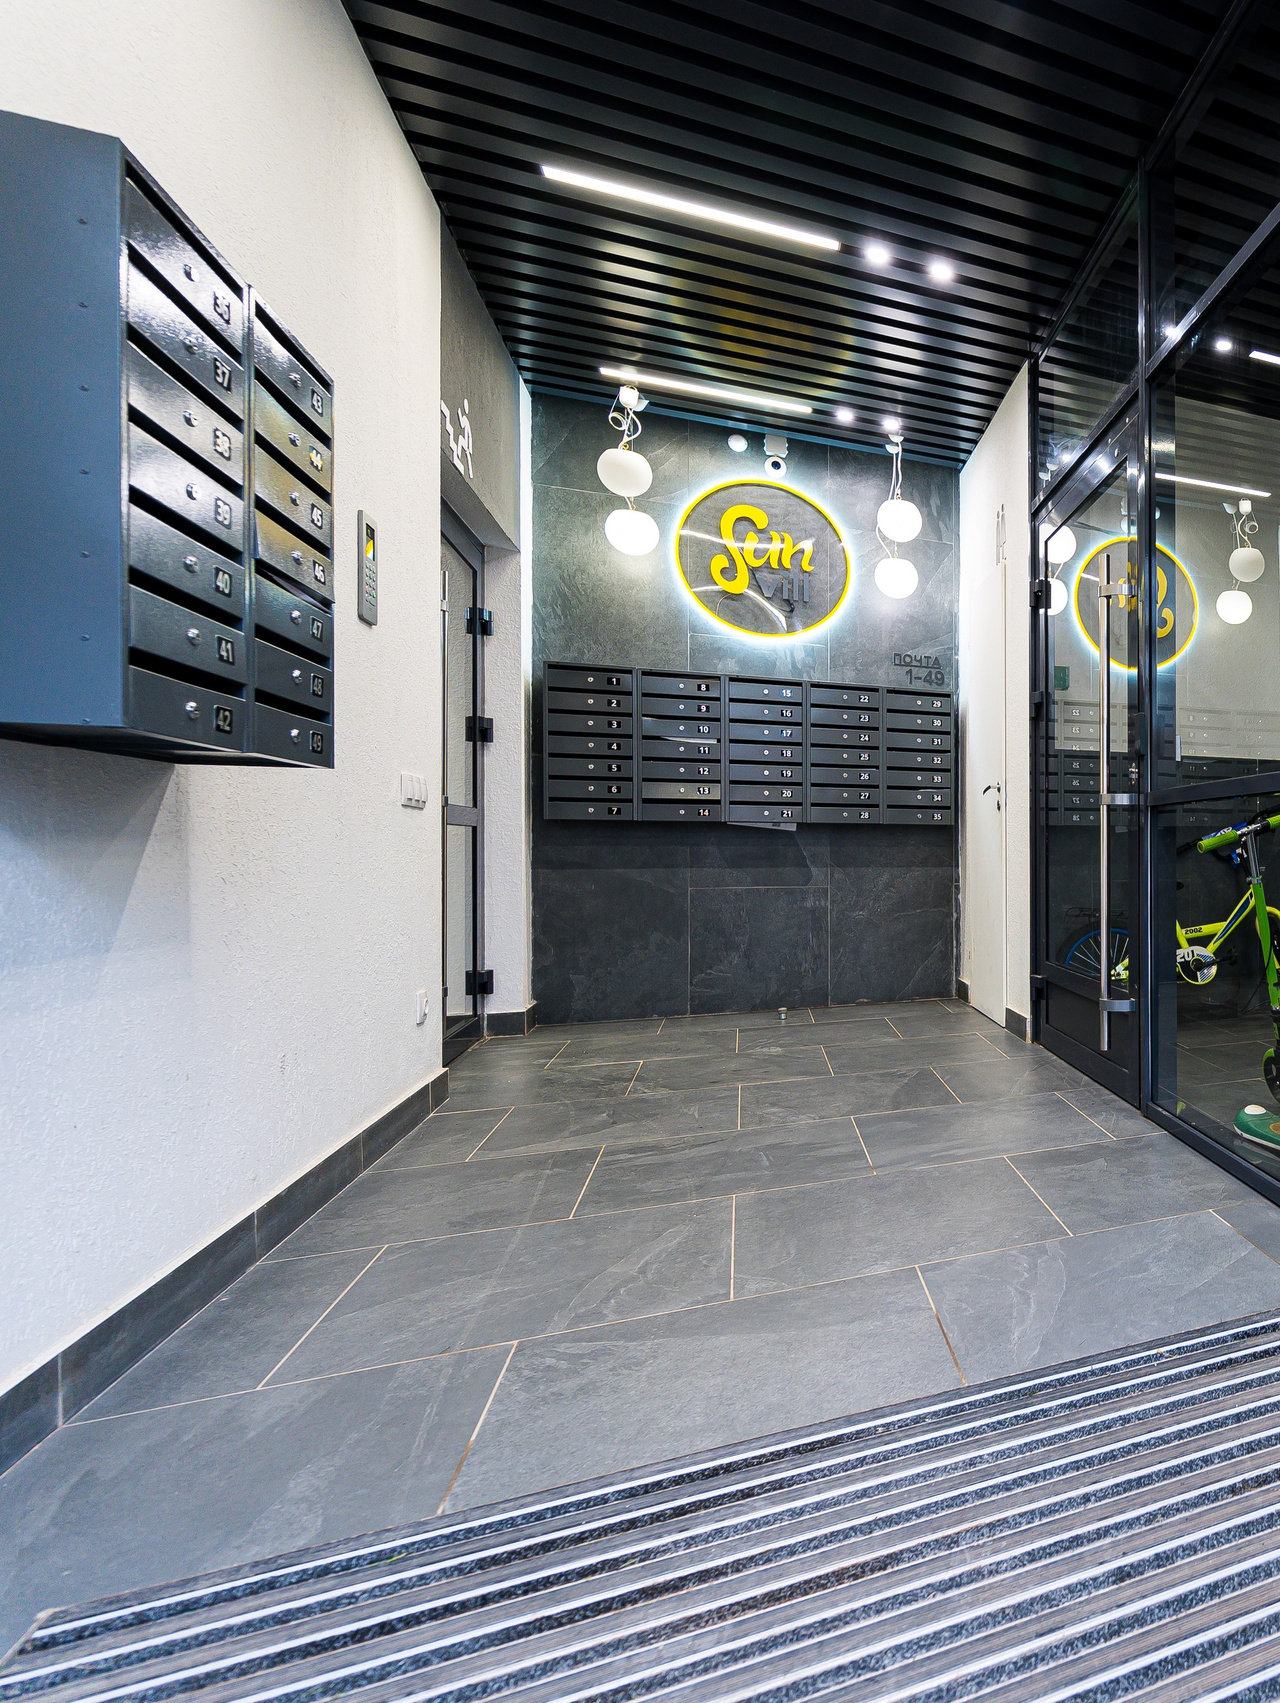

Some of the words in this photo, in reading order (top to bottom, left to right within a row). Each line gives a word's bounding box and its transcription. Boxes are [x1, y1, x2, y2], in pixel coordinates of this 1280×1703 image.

[214, 292, 230, 321] 36
[214, 358, 230, 389] 37
[311, 391, 322, 414] 43
[214, 430, 231, 458] 38
[310, 450, 323, 469] 44
[215, 499, 231, 526] 39
[311, 506, 323, 526] 45
[710, 504, 814, 595] Sun
[215, 569, 231, 595] 40
[313, 563, 325, 582] 46
[757, 571, 810, 602] vill
[311, 619, 323, 638] 47
[218, 639, 234, 662] 41
[893, 653, 941, 668] ПОЧТА
[312, 676, 323, 695] 48
[905, 669, 945, 686] 1-49
[216, 709, 232, 731] 42
[312, 734, 323, 752] 49
[1184, 926, 1203, 935] 2002
